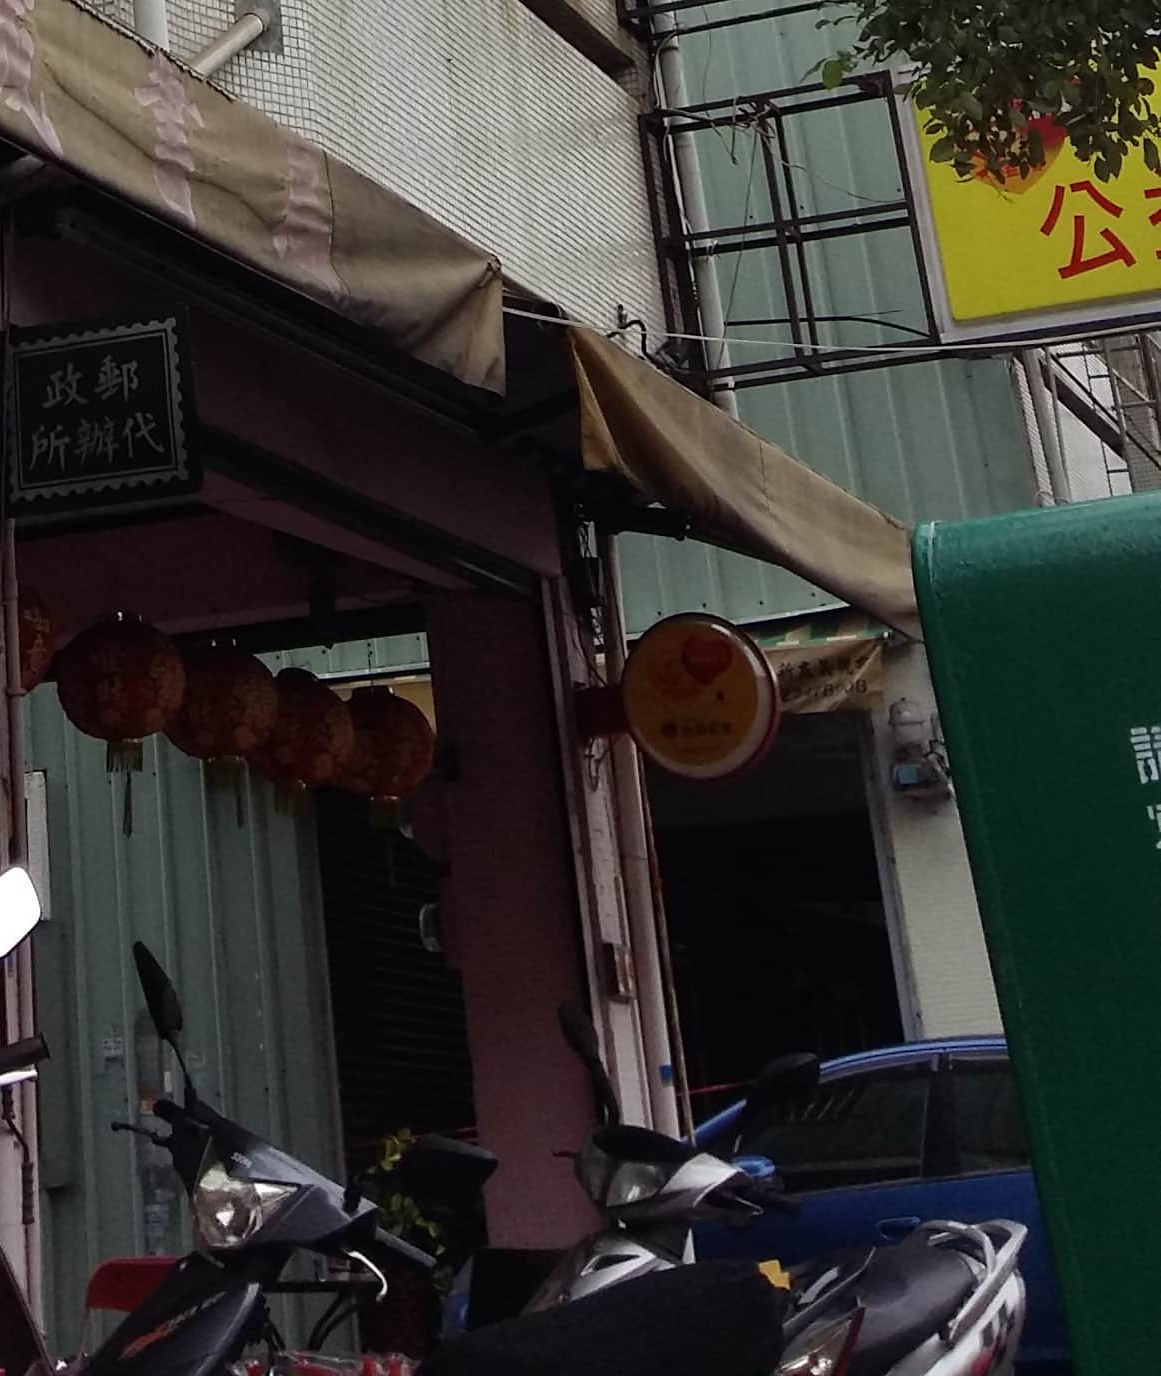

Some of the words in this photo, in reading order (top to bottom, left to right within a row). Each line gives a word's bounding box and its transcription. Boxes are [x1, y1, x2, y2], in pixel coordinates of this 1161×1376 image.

[42, 353, 138, 409] 郵政
[30, 411, 165, 472] 代辦所
